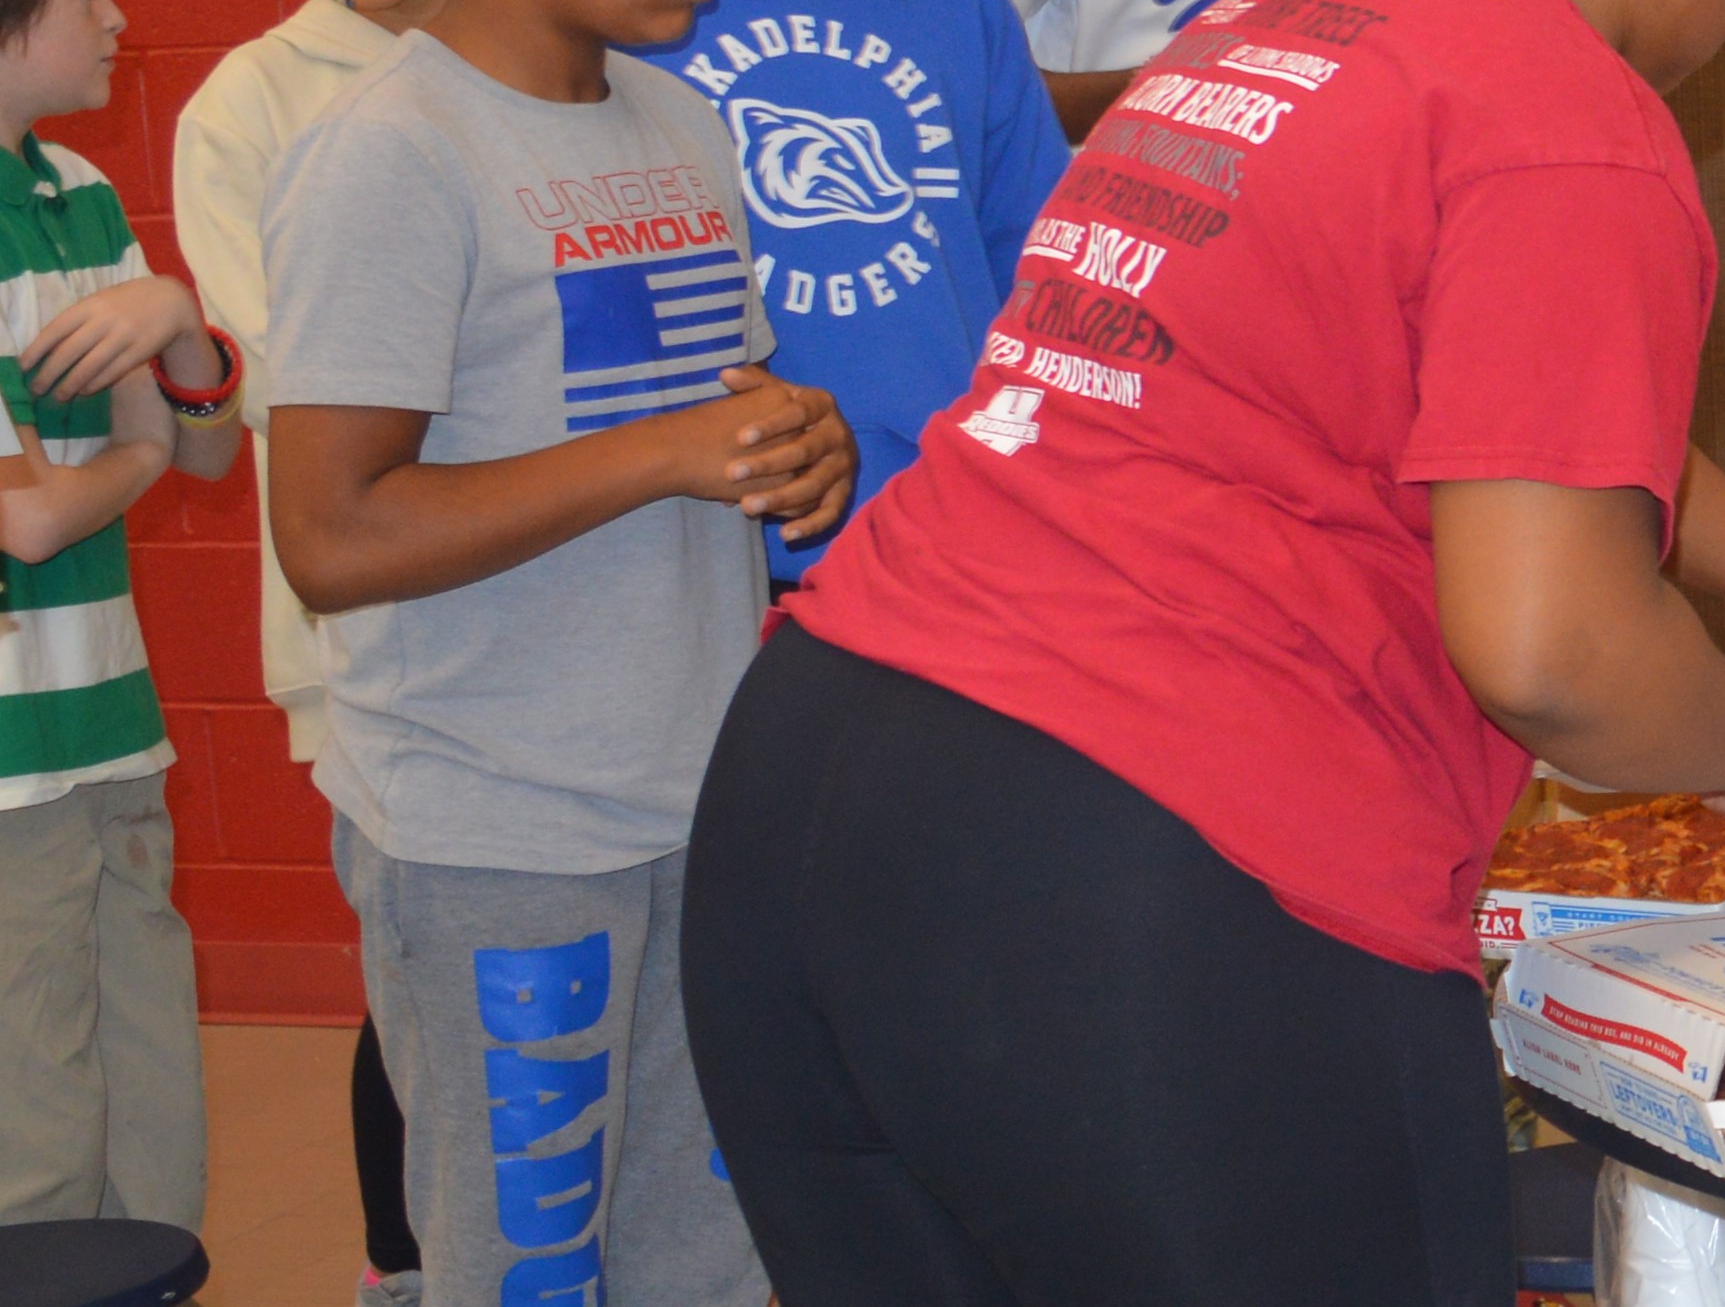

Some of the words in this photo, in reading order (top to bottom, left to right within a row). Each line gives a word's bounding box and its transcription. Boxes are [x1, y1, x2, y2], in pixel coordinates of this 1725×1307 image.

[685, 14, 955, 153] KADELPHIA
[1172, 81, 1294, 145] BEARERS
[515, 164, 722, 234] UNDER
[1104, 173, 1231, 248] FRIENDSHIP
[554, 210, 734, 268] ARMOUR
[753, 211, 943, 317] ADGERS
[1072, 221, 1168, 299] HOLLY
[1025, 278, 1175, 366] CHILDREN
[1023, 346, 1142, 409] HENDERSON!
[1549, 1005, 1564, 1019] STOP
[1564, 1012, 1589, 1030] READING
[1619, 1029, 1633, 1043] AND
[1653, 1042, 1680, 1062] ALREADY
